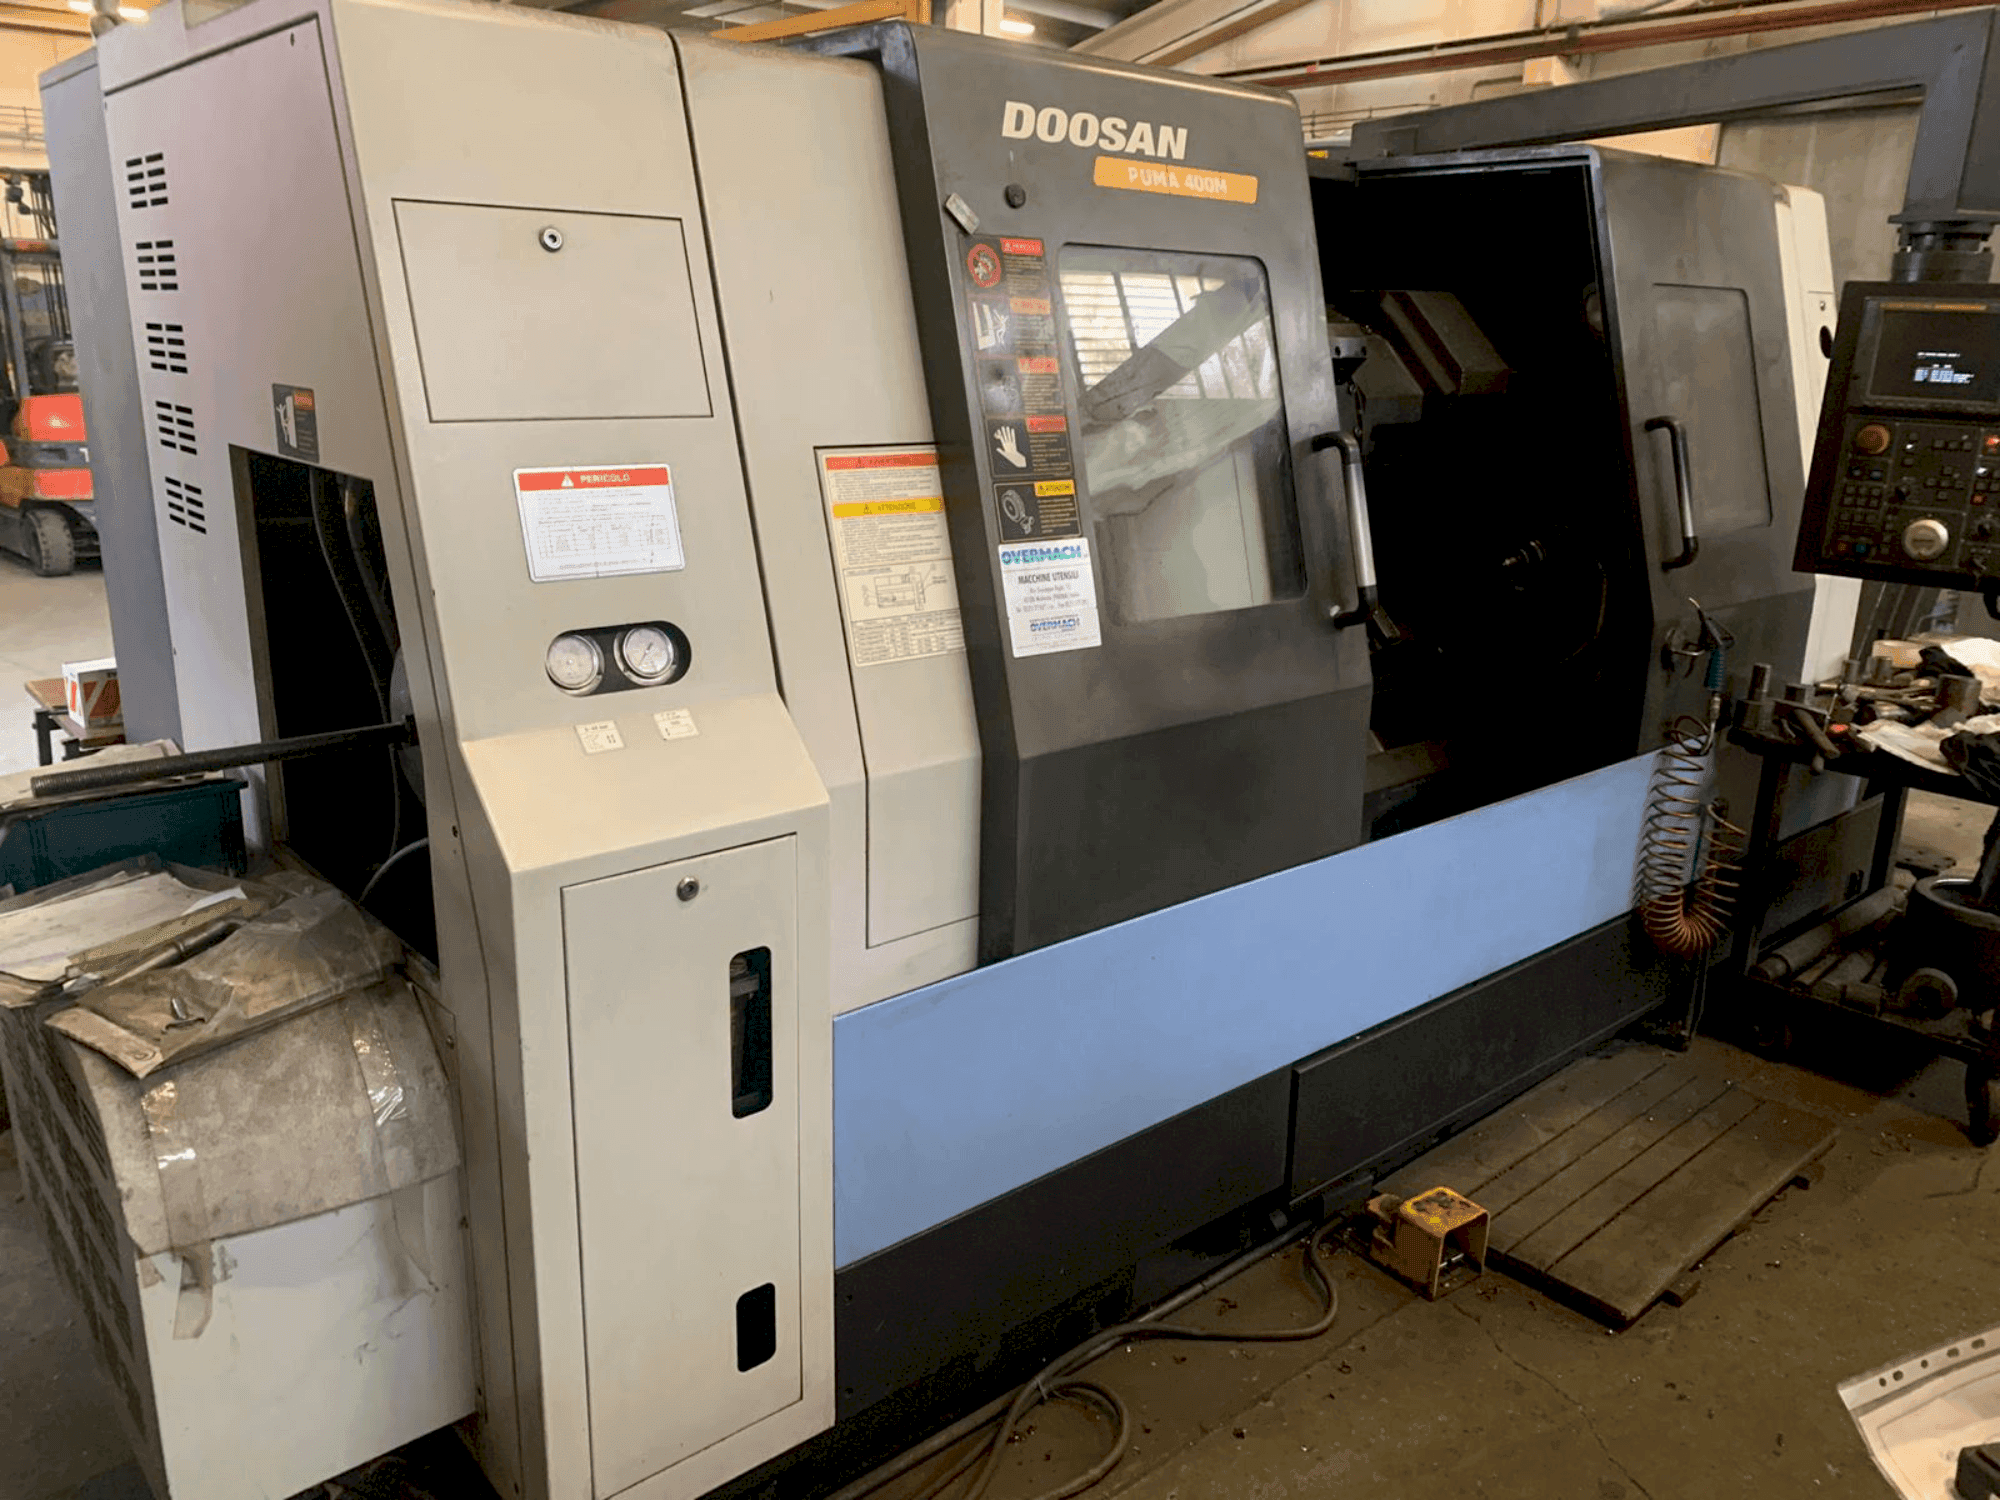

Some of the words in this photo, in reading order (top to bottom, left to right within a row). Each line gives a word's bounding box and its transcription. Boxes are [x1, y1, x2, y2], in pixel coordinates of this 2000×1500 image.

[1002, 100, 1188, 160] DOOSAN
[1128, 166, 1180, 188] PUMA
[580, 472, 631, 484] PERICOLO
[1001, 545, 1082, 565] OVERMACH
[1018, 572, 1051, 584] MACCHINE
